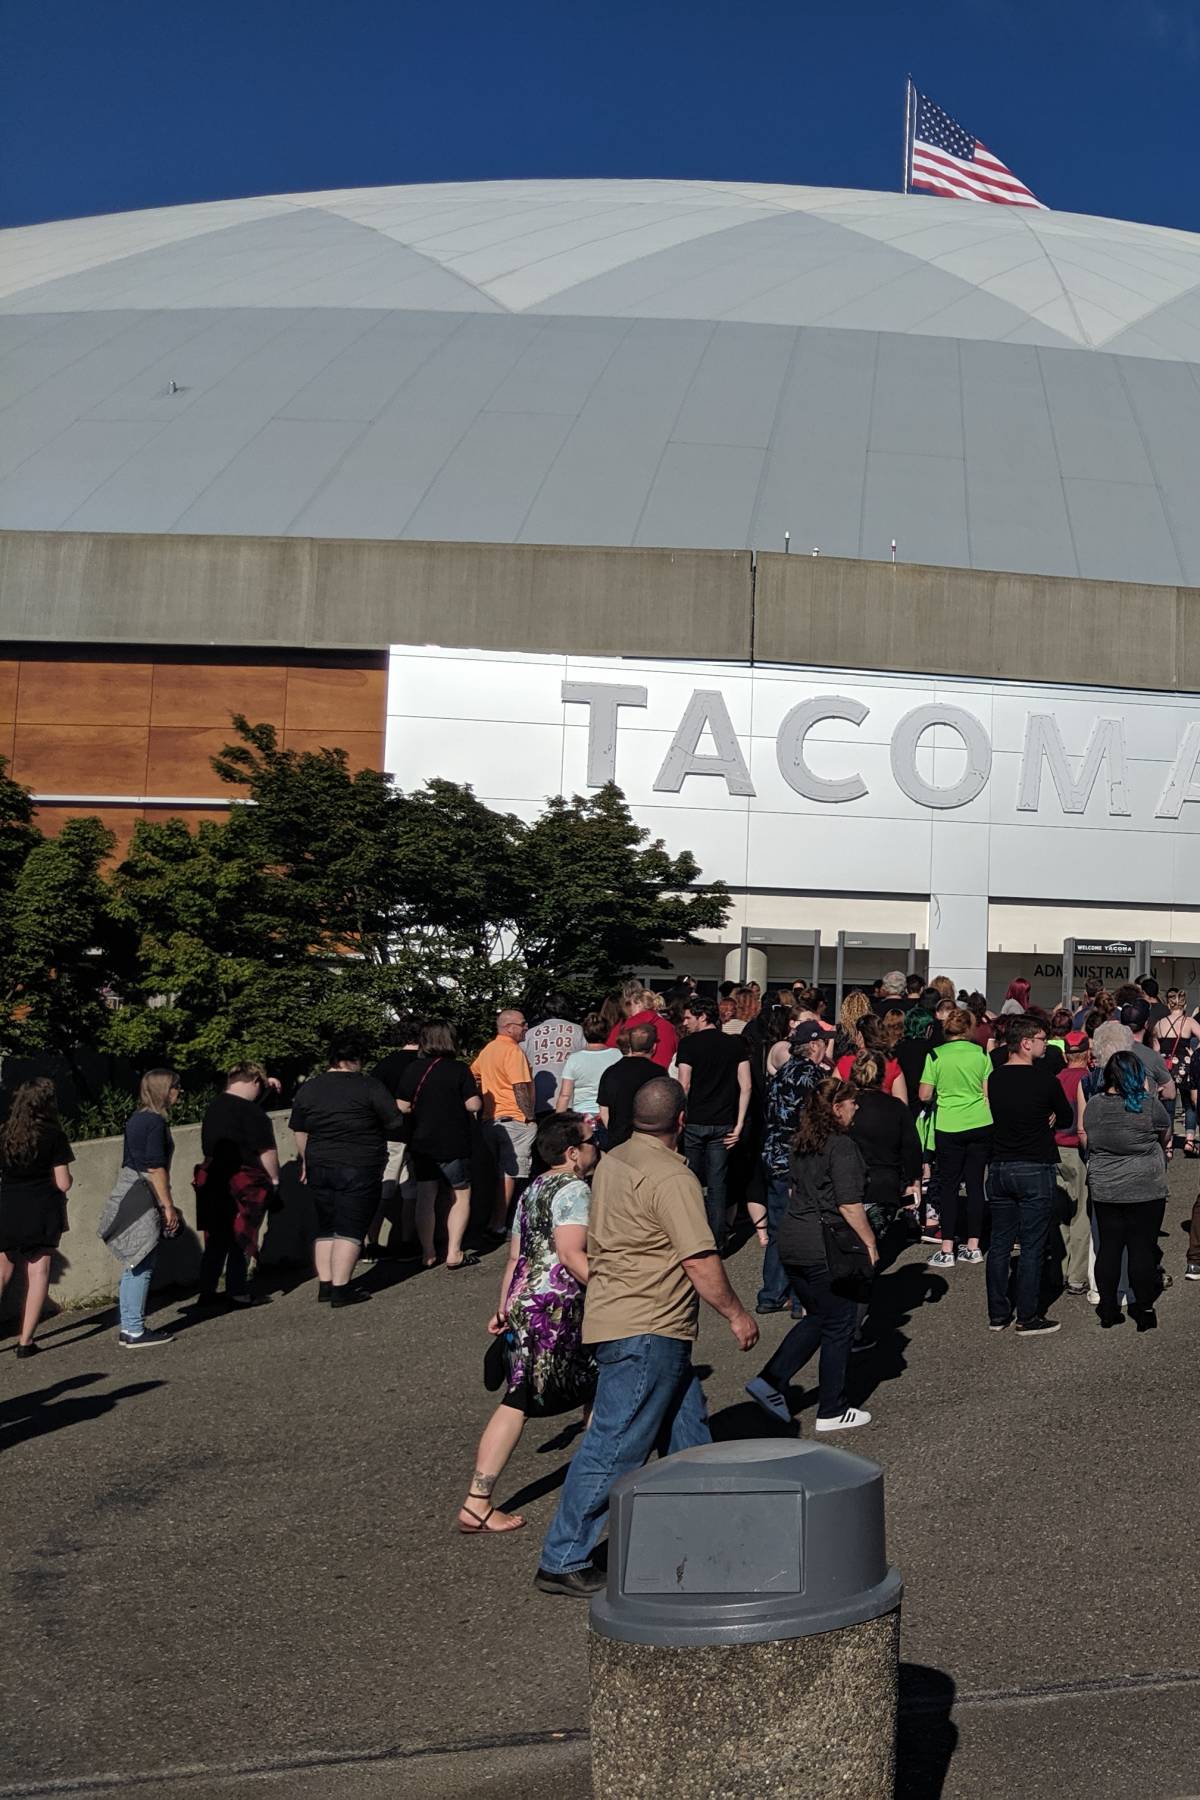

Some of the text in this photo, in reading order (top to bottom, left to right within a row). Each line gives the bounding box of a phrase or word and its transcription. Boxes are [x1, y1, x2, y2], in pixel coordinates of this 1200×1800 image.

[1034, 964, 1158, 980] ADMNISTRATN
[534, 1024, 573, 1037] 63-14
[534, 1036, 572, 1051] 14-03
